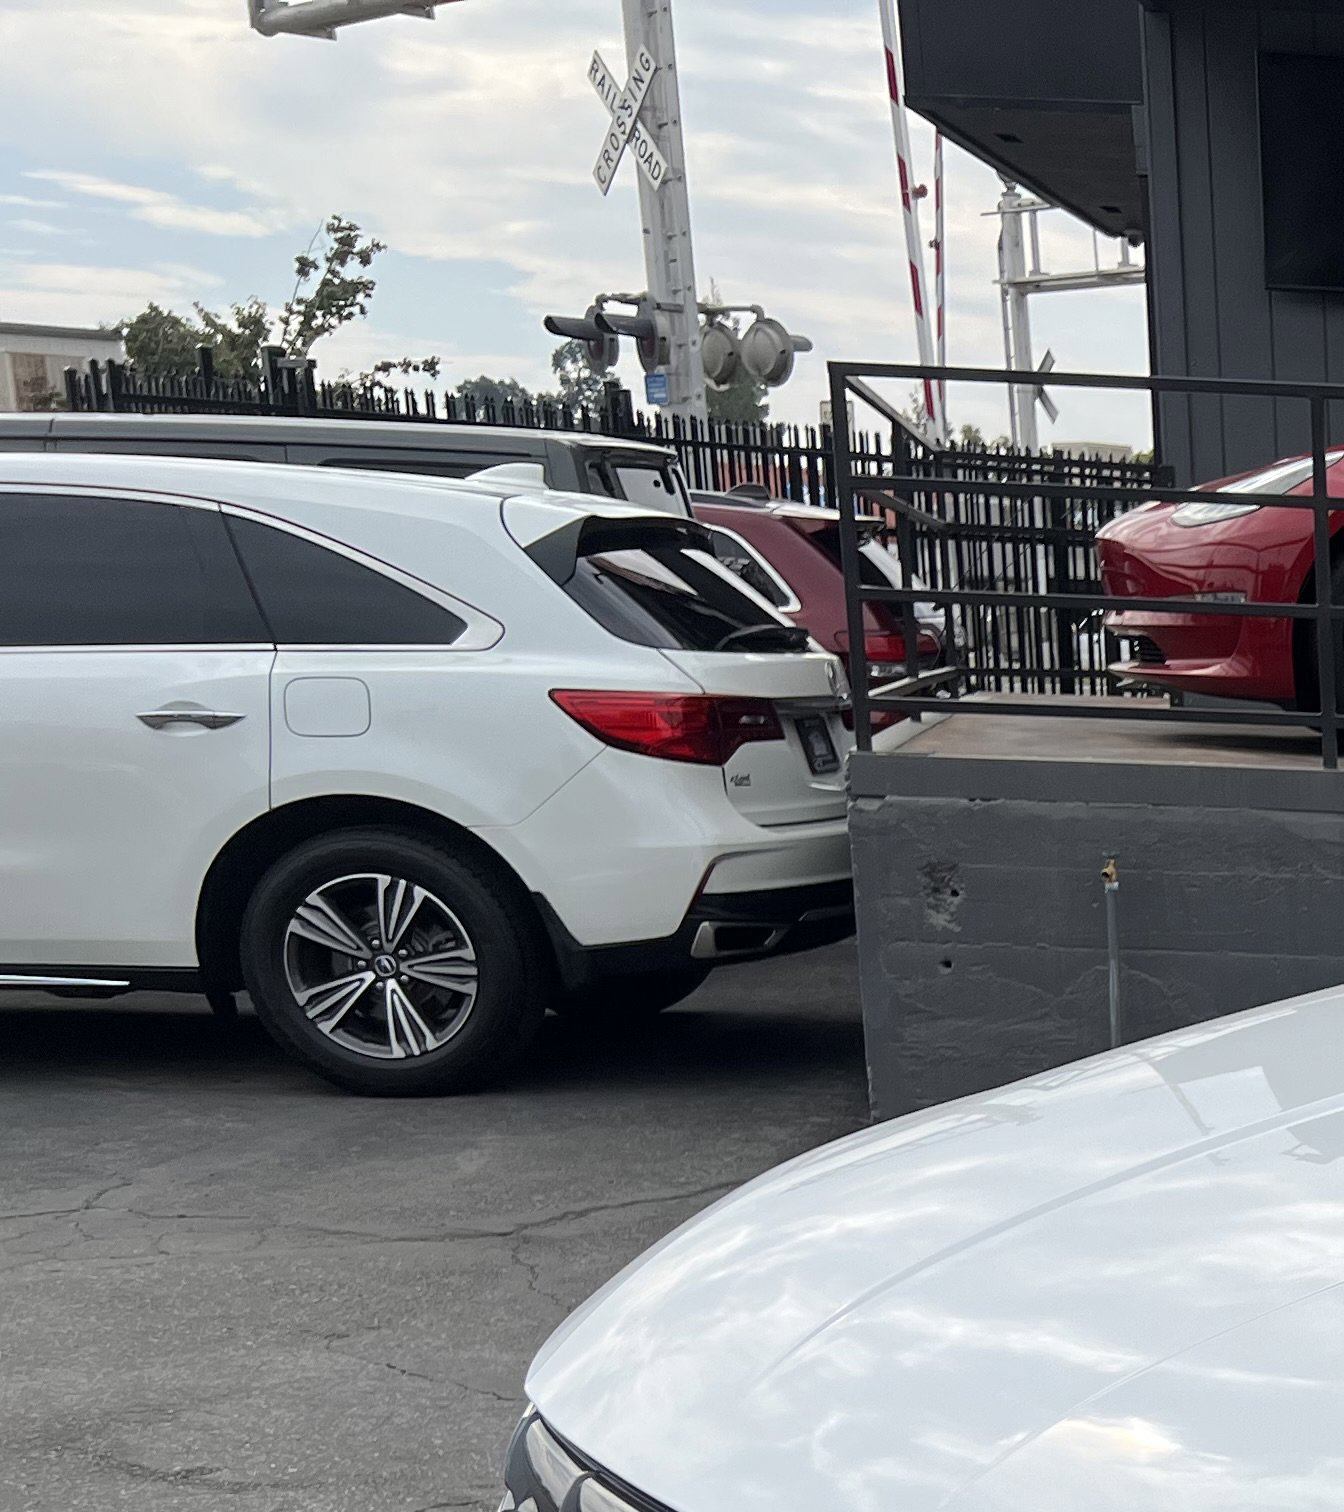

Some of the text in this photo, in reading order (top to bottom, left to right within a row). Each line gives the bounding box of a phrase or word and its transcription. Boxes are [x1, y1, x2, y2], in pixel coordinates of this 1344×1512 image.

[589, 58, 662, 182] RAIL ROAD
[595, 51, 651, 185] CROSSING
